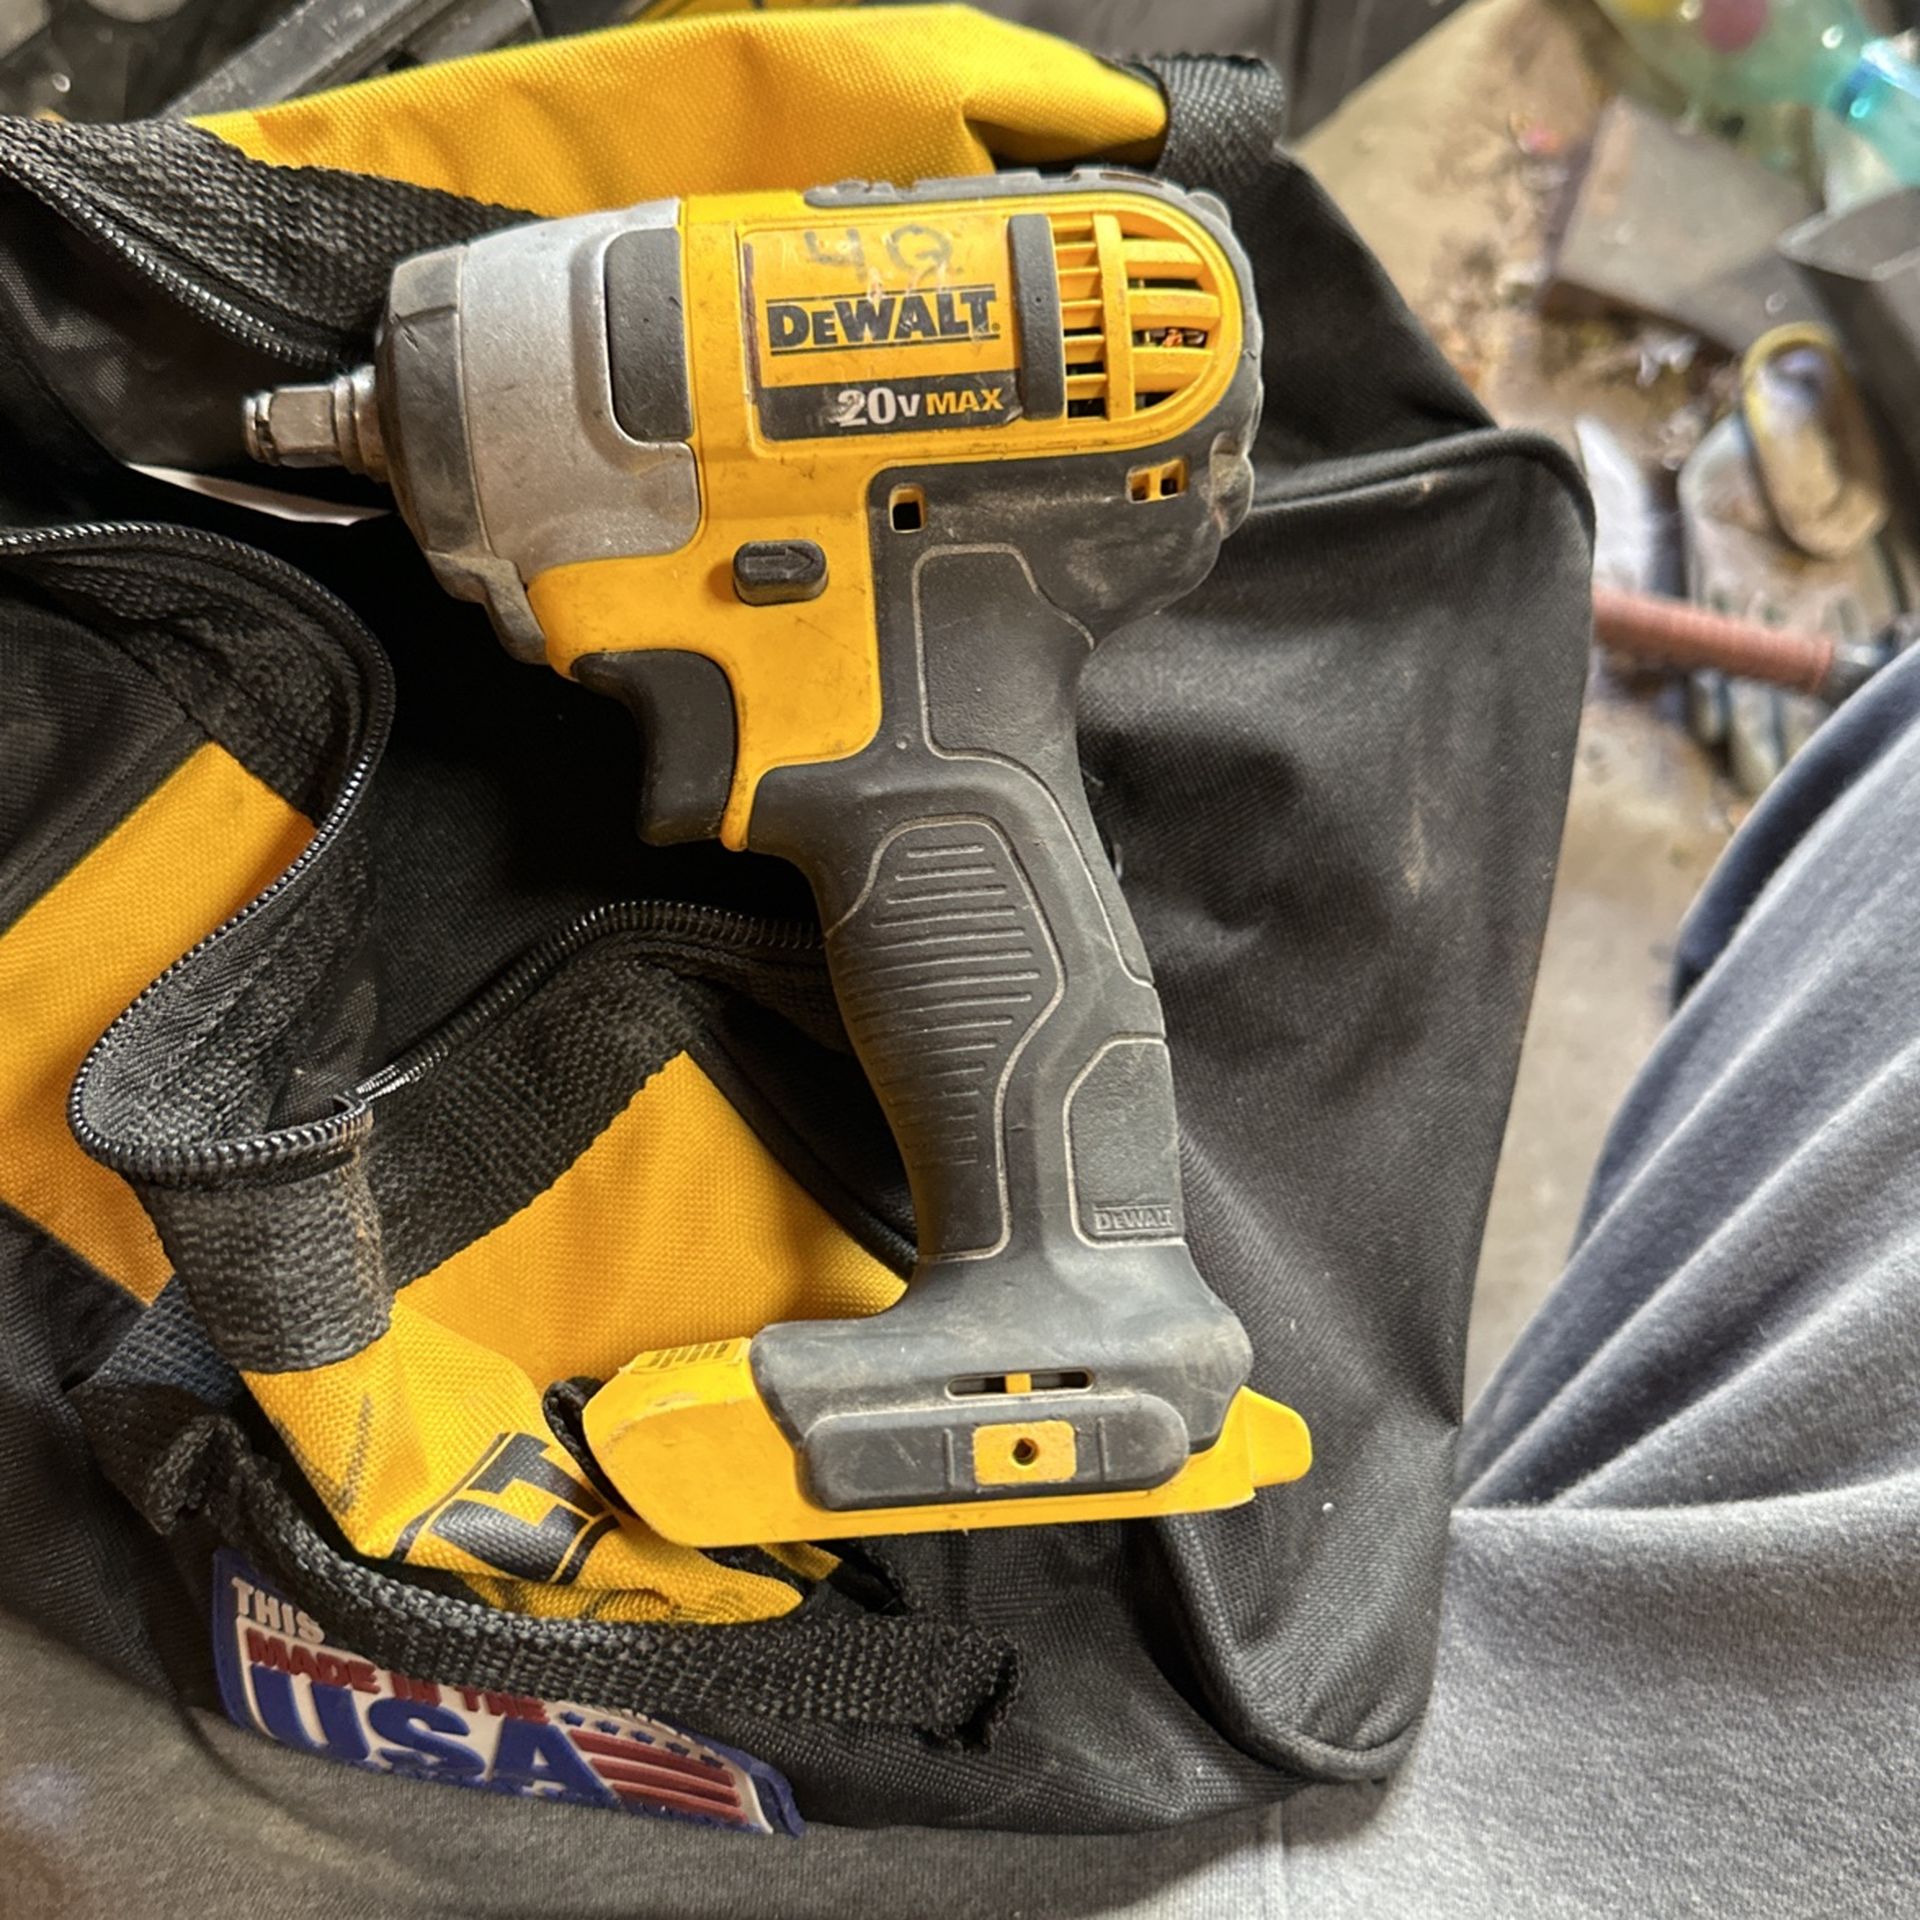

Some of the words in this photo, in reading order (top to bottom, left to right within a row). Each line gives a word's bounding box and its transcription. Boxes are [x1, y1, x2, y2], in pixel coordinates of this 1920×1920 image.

[925, 388, 1004, 417] MAX
[231, 1576, 326, 1644] THIS
[246, 1627, 382, 1695] MADE
[389, 1670, 442, 1708] IN
[453, 1684, 551, 1726] THE
[249, 1663, 624, 1809] USA
